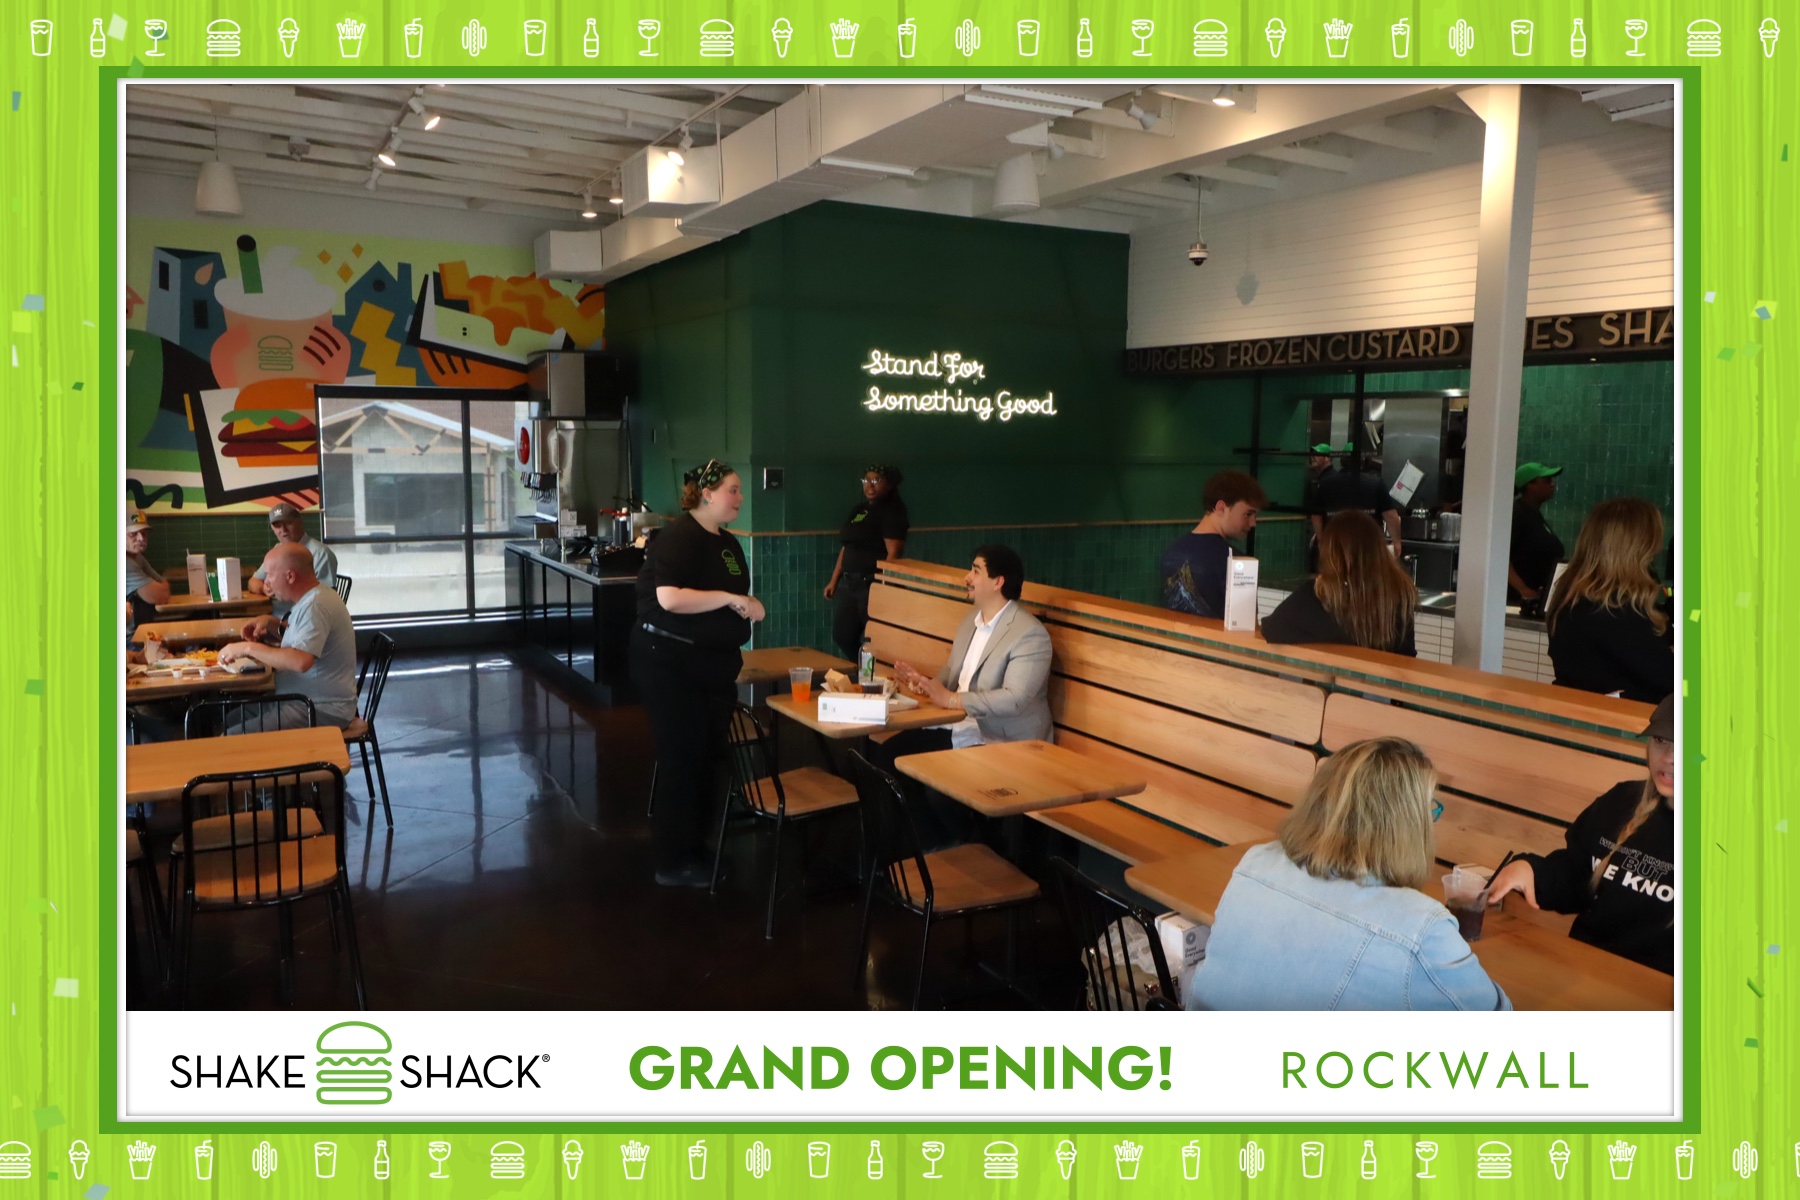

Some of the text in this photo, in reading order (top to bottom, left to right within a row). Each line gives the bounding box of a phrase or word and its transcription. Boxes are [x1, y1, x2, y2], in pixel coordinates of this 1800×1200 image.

[862, 349, 985, 384] Stand For
[1128, 345, 1214, 373] BURGERS
[1226, 337, 1321, 367] FROZEN
[1328, 326, 1460, 362] CUSTARD
[863, 386, 1057, 421] Something Good
[1621, 855, 1668, 882] BUT
